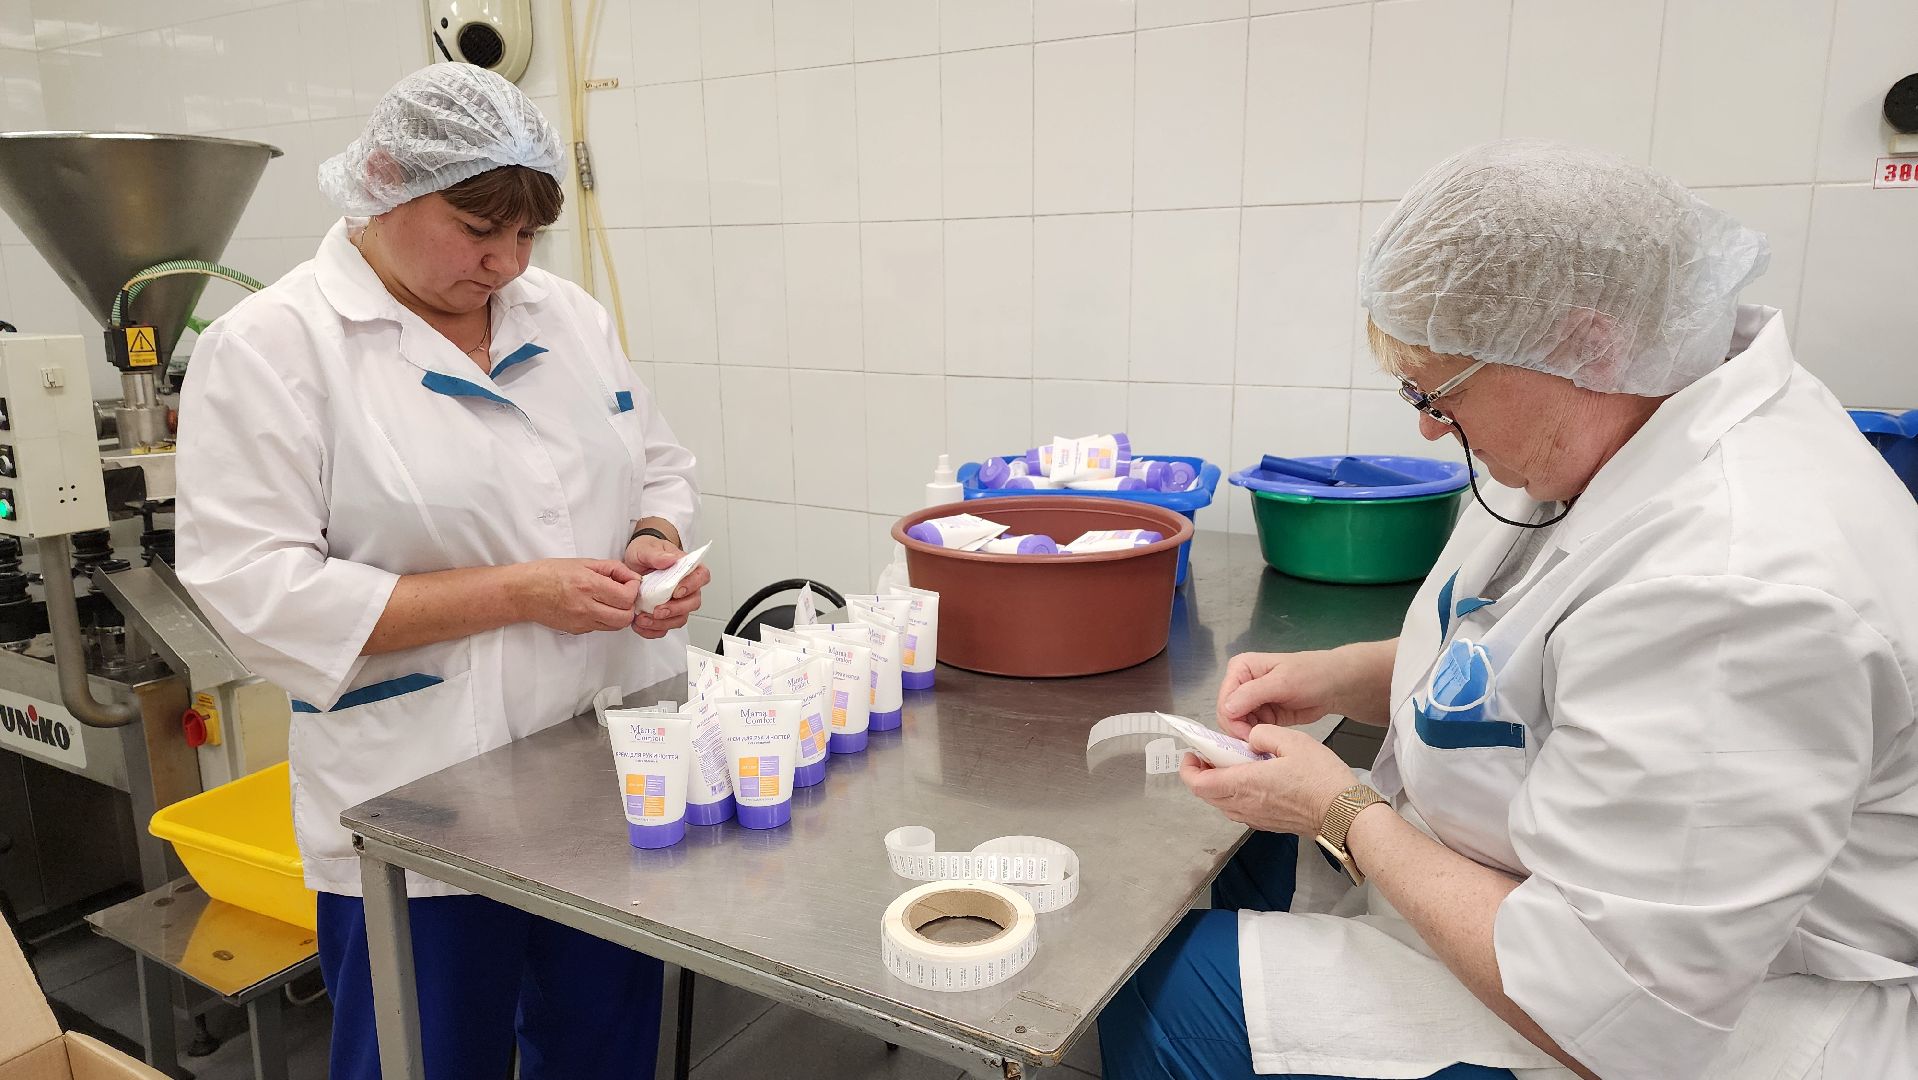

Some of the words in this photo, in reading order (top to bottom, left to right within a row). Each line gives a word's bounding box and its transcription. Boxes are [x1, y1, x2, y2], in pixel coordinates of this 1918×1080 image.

[741, 708, 768, 718] Mama
[745, 716, 776, 725] Comfort
[631, 724, 657, 735] Mama
